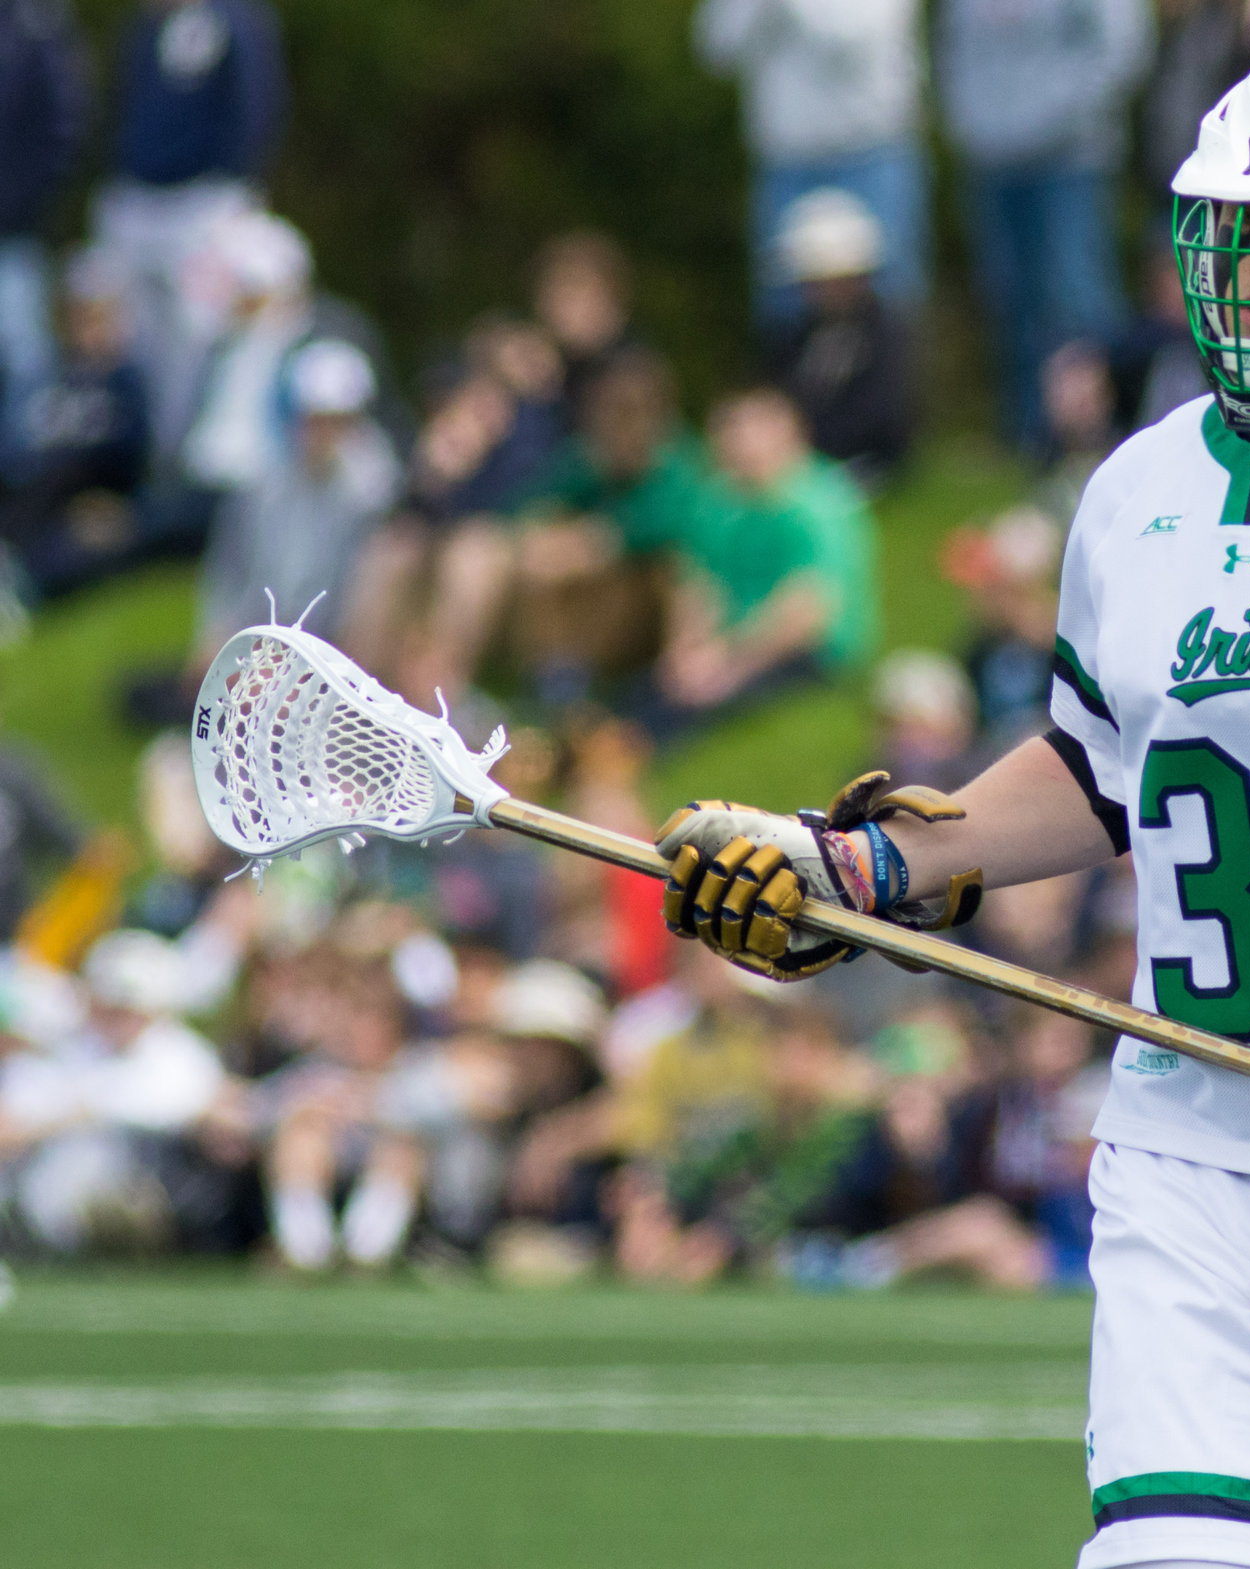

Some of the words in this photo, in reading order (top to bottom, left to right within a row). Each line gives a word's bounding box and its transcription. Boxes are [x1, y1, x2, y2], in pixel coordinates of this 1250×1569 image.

[1140, 515, 1182, 535] ACC
[196, 705, 211, 740] STX
[876, 852, 886, 881] DON'T
